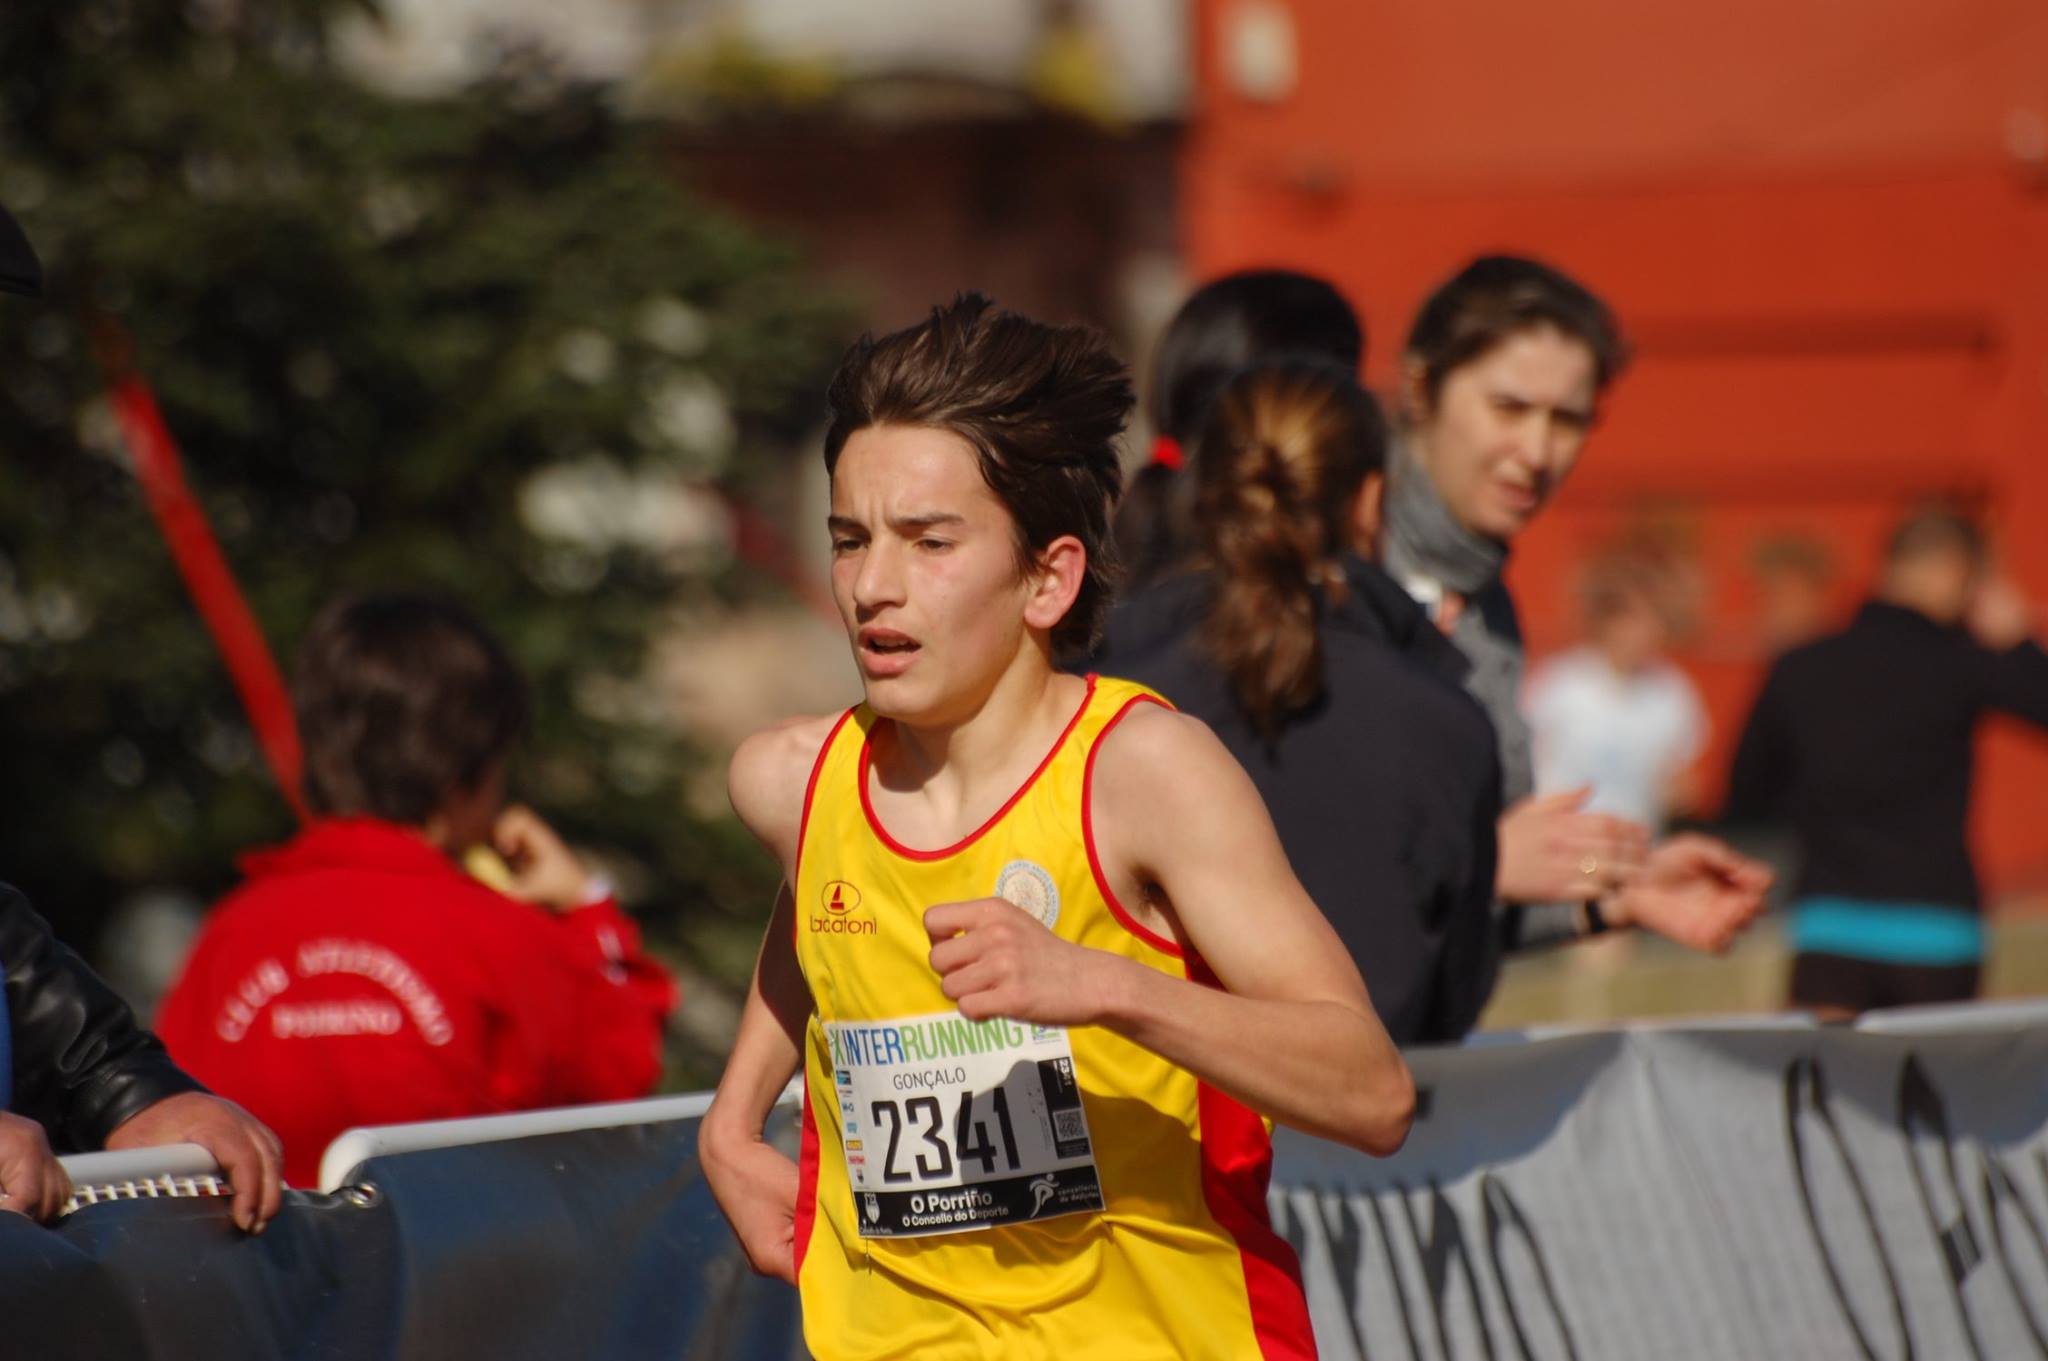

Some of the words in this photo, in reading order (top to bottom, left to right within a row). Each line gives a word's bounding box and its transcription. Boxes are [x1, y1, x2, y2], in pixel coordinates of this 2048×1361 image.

[809, 914, 877, 935] lacatoni
[892, 1067, 967, 1091] GONÇALO
[871, 1087, 1021, 1184] 2341
[910, 1197, 925, 1214] O
[928, 1188, 993, 1211] Porriño
[902, 1215, 910, 1227] O
[953, 1210, 968, 1222] do
[969, 1206, 1009, 1221] Deporte
